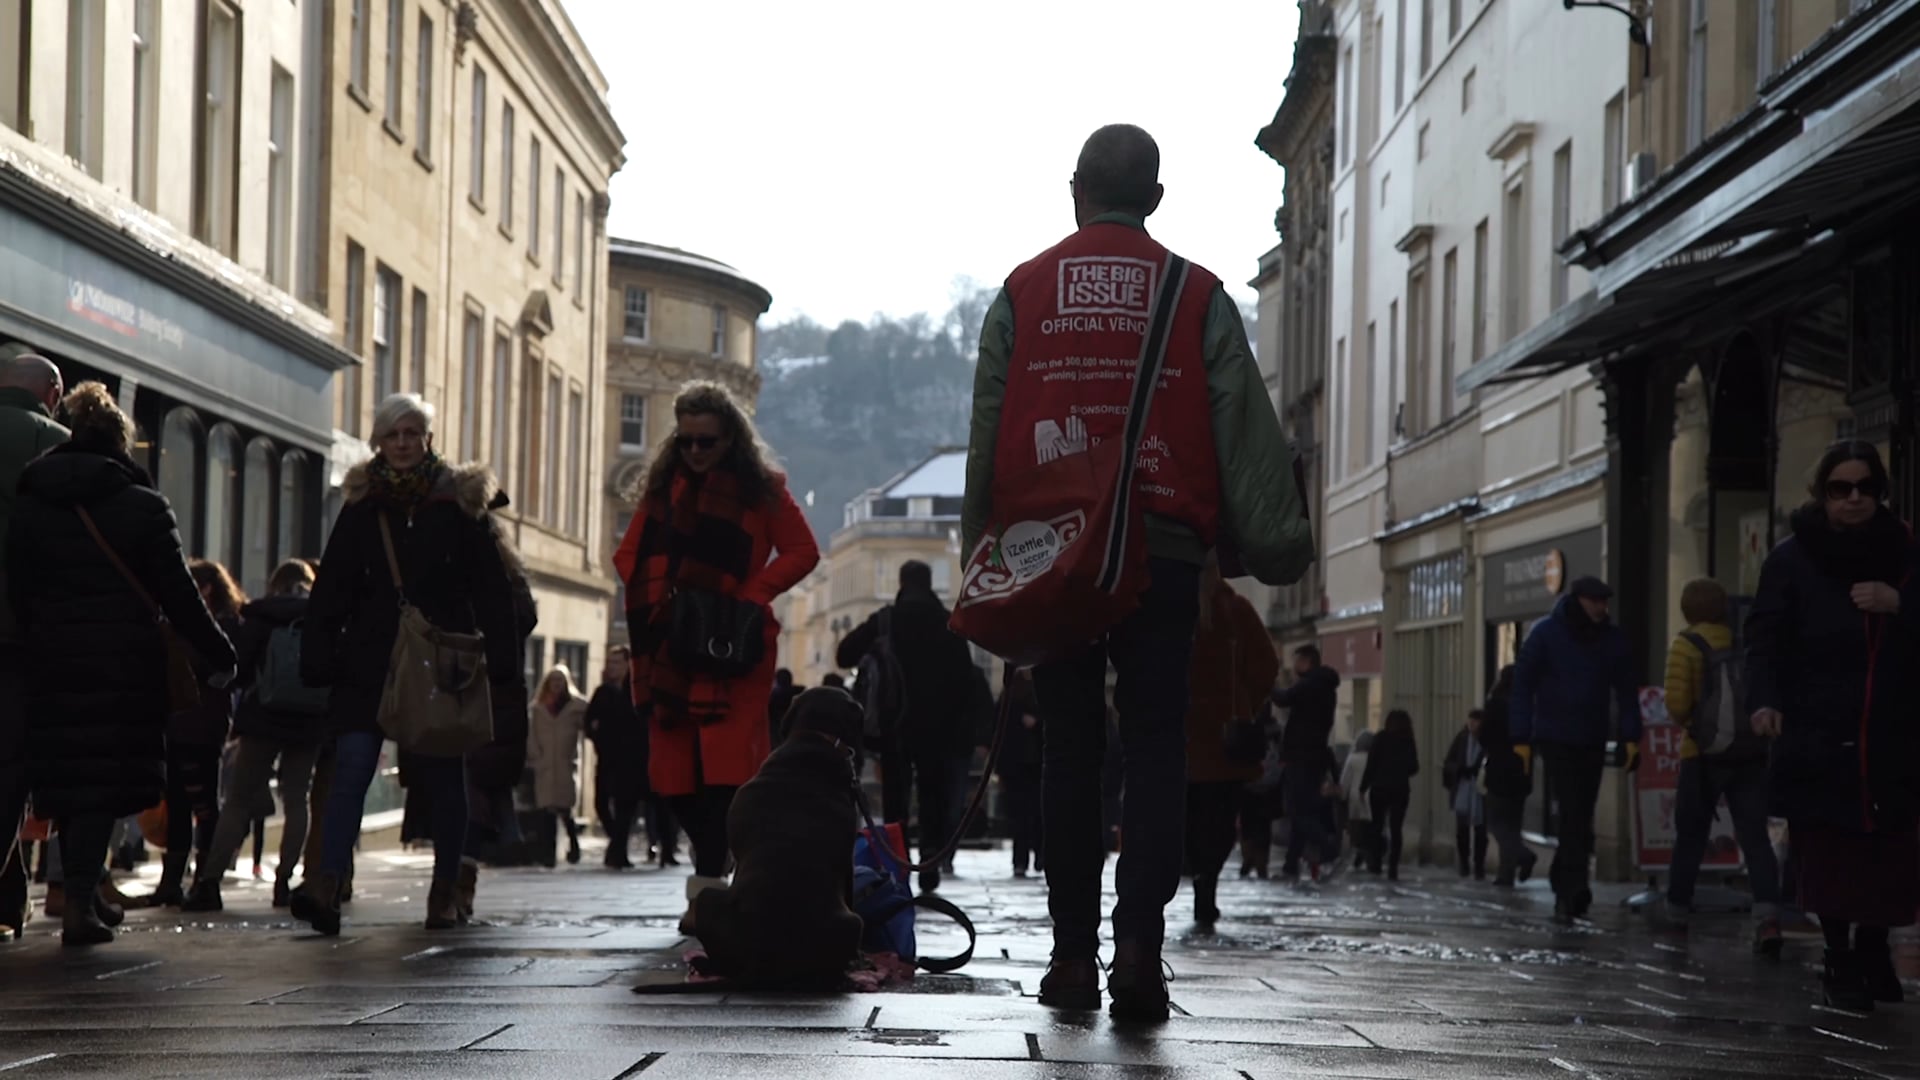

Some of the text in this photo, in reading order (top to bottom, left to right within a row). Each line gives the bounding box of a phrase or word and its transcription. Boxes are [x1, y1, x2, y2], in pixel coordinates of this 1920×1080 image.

[1069, 264, 1145, 284] THE BIG
[1068, 281, 1145, 307] ISSUE
[1041, 316, 1148, 336] OFFICIAL VEND
[1026, 360, 1048, 371] Join
[1048, 359, 1063, 368] the
[1098, 357, 1118, 367] who
[1070, 404, 1130, 415] SONSORED
[1006, 537, 1044, 558] iZettle
